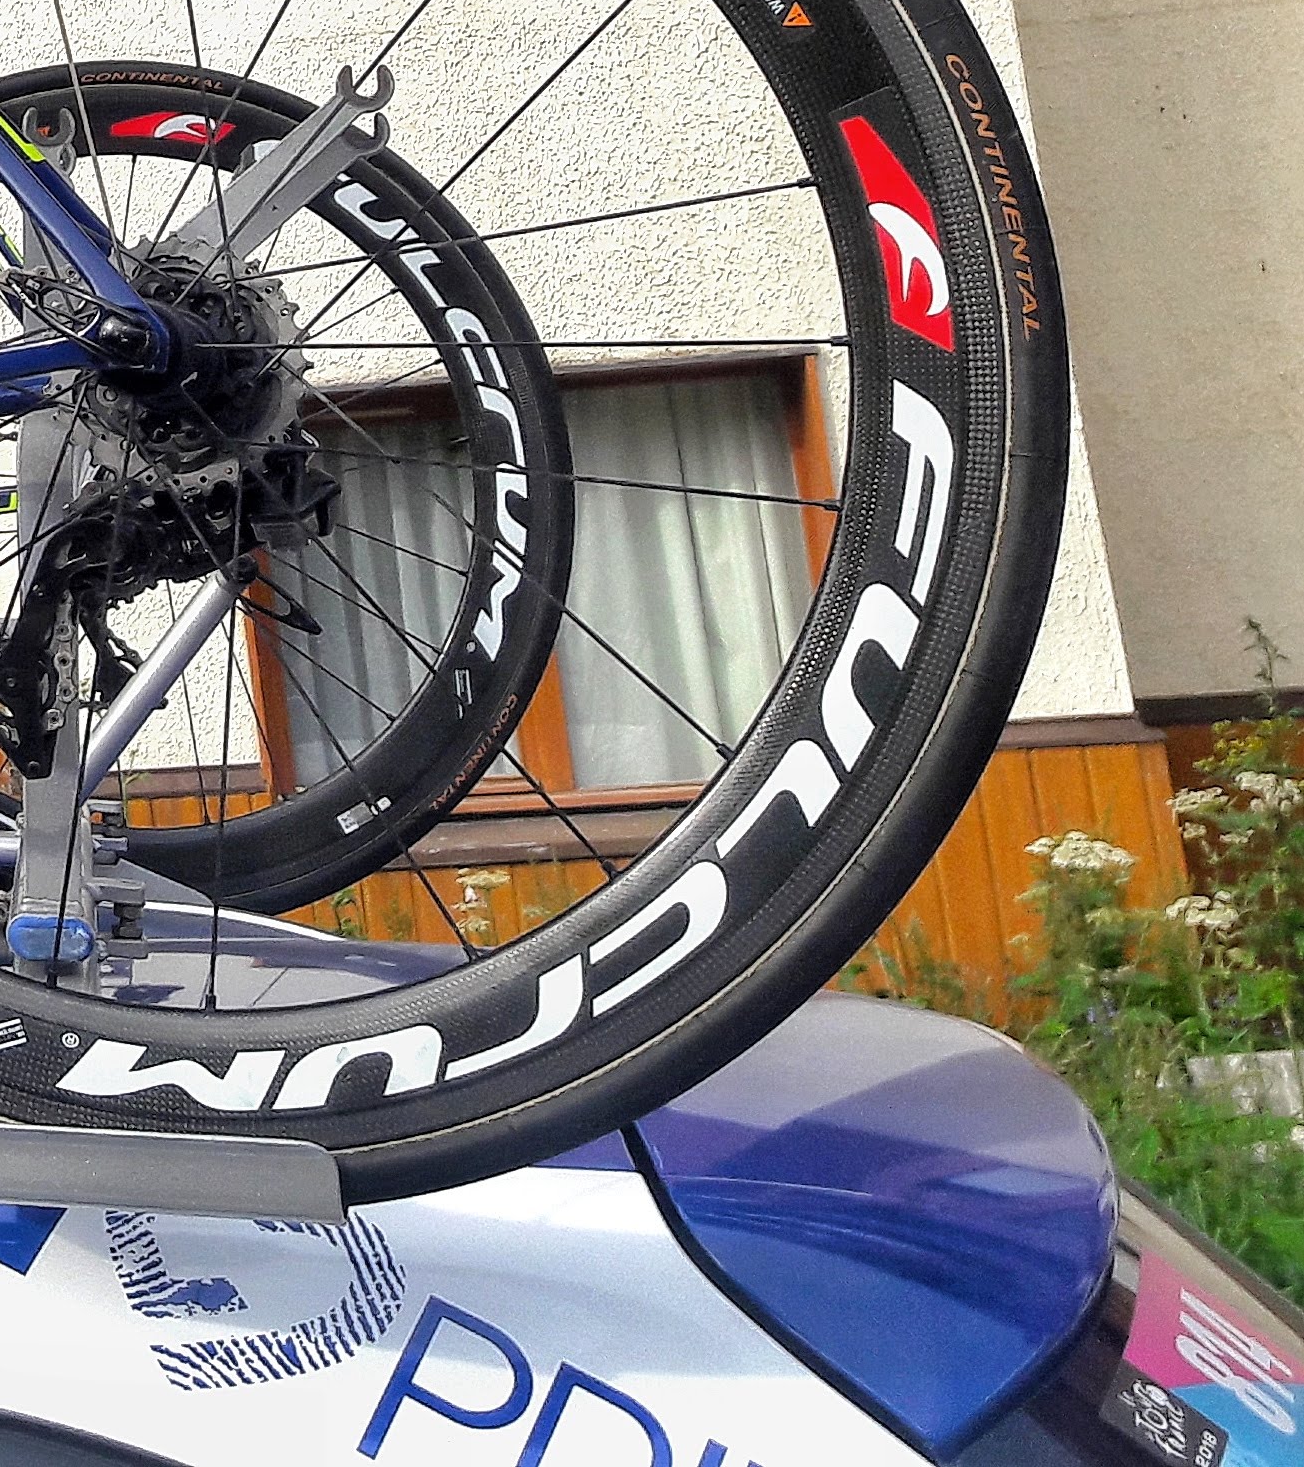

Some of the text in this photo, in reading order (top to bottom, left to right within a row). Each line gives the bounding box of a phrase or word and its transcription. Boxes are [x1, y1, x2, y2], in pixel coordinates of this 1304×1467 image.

[80, 70, 225, 91] CONTINENTAL
[944, 53, 1041, 341] CONTINENTAL
[56, 380, 954, 1110] FULCRUM
